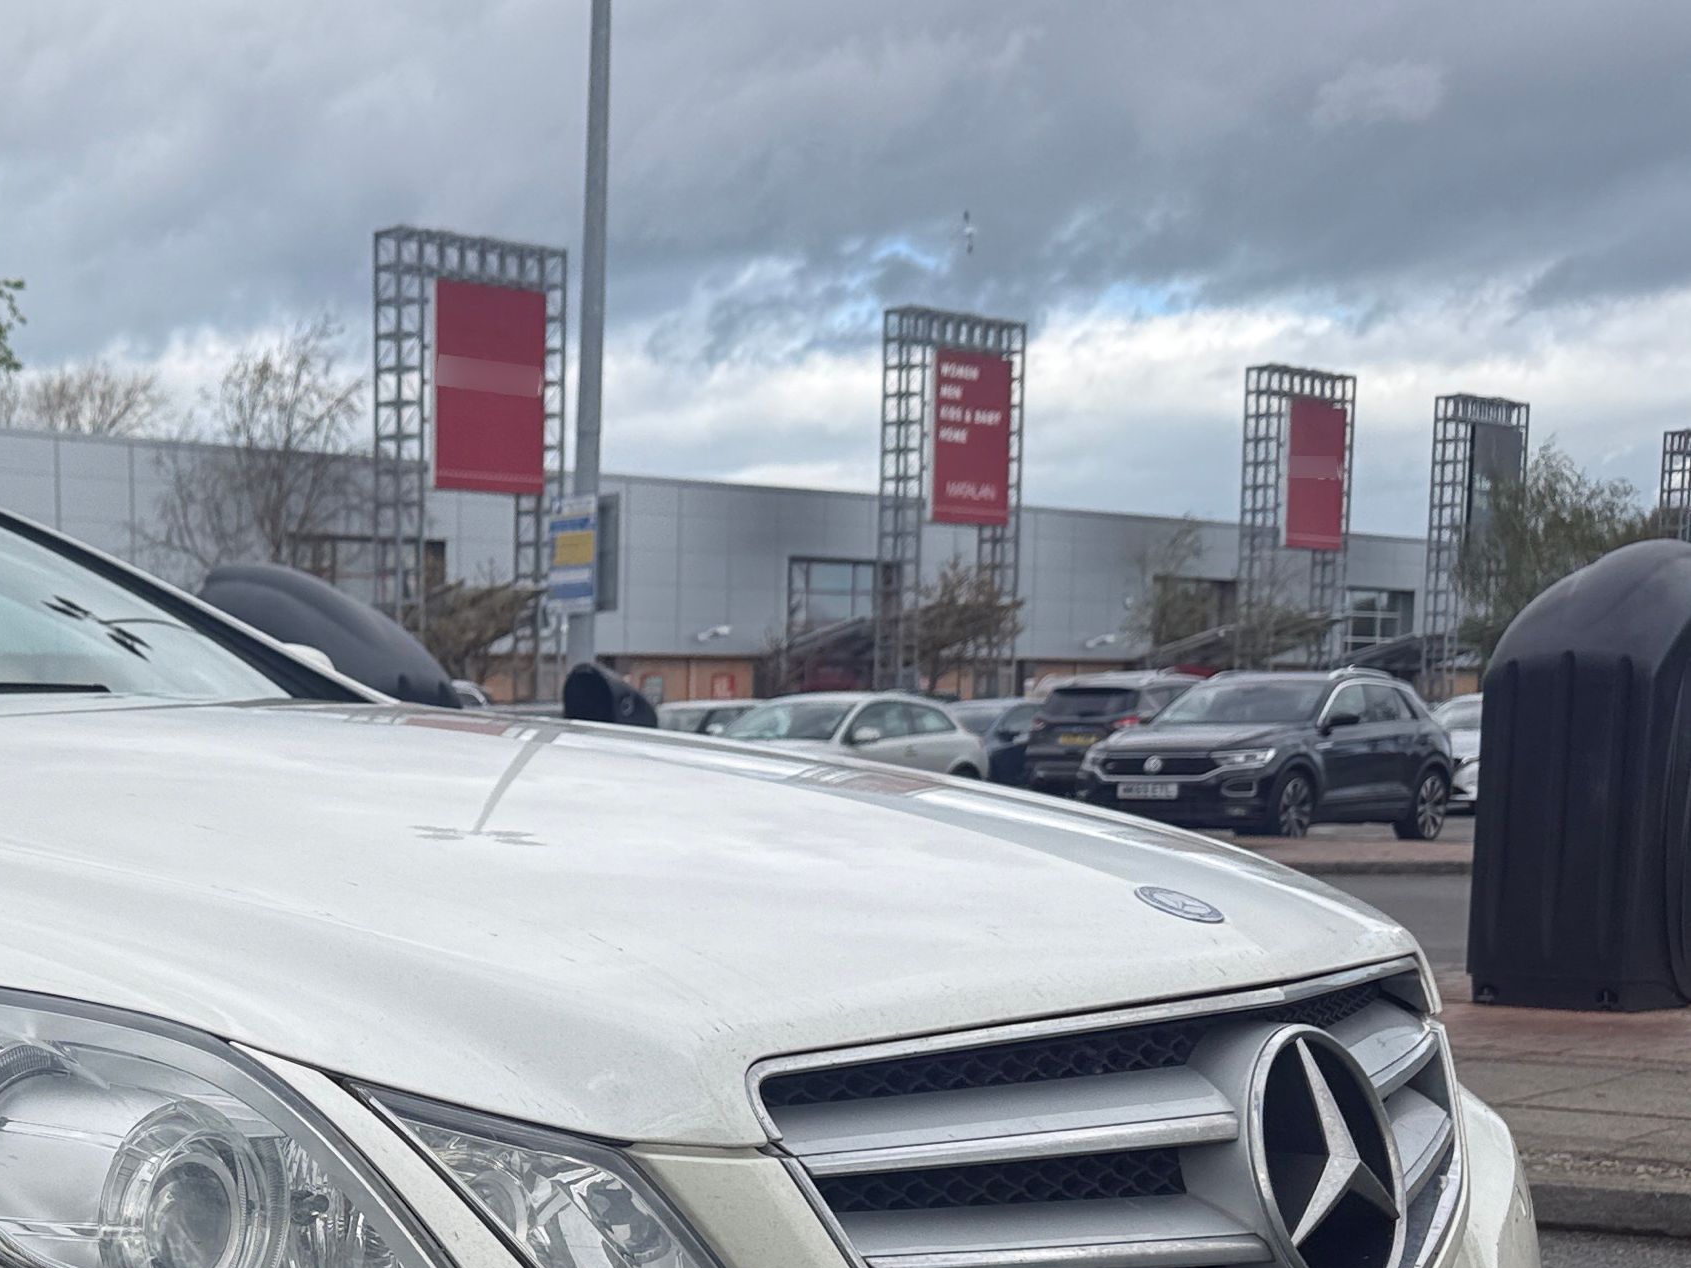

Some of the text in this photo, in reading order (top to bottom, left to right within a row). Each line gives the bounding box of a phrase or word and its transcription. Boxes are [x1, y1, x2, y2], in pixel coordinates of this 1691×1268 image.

[940, 362, 980, 381] WOMEN
[939, 384, 963, 400] MEN
[939, 405, 963, 422] KIDS
[974, 409, 1002, 426] BABY
[939, 427, 968, 444] HOME
